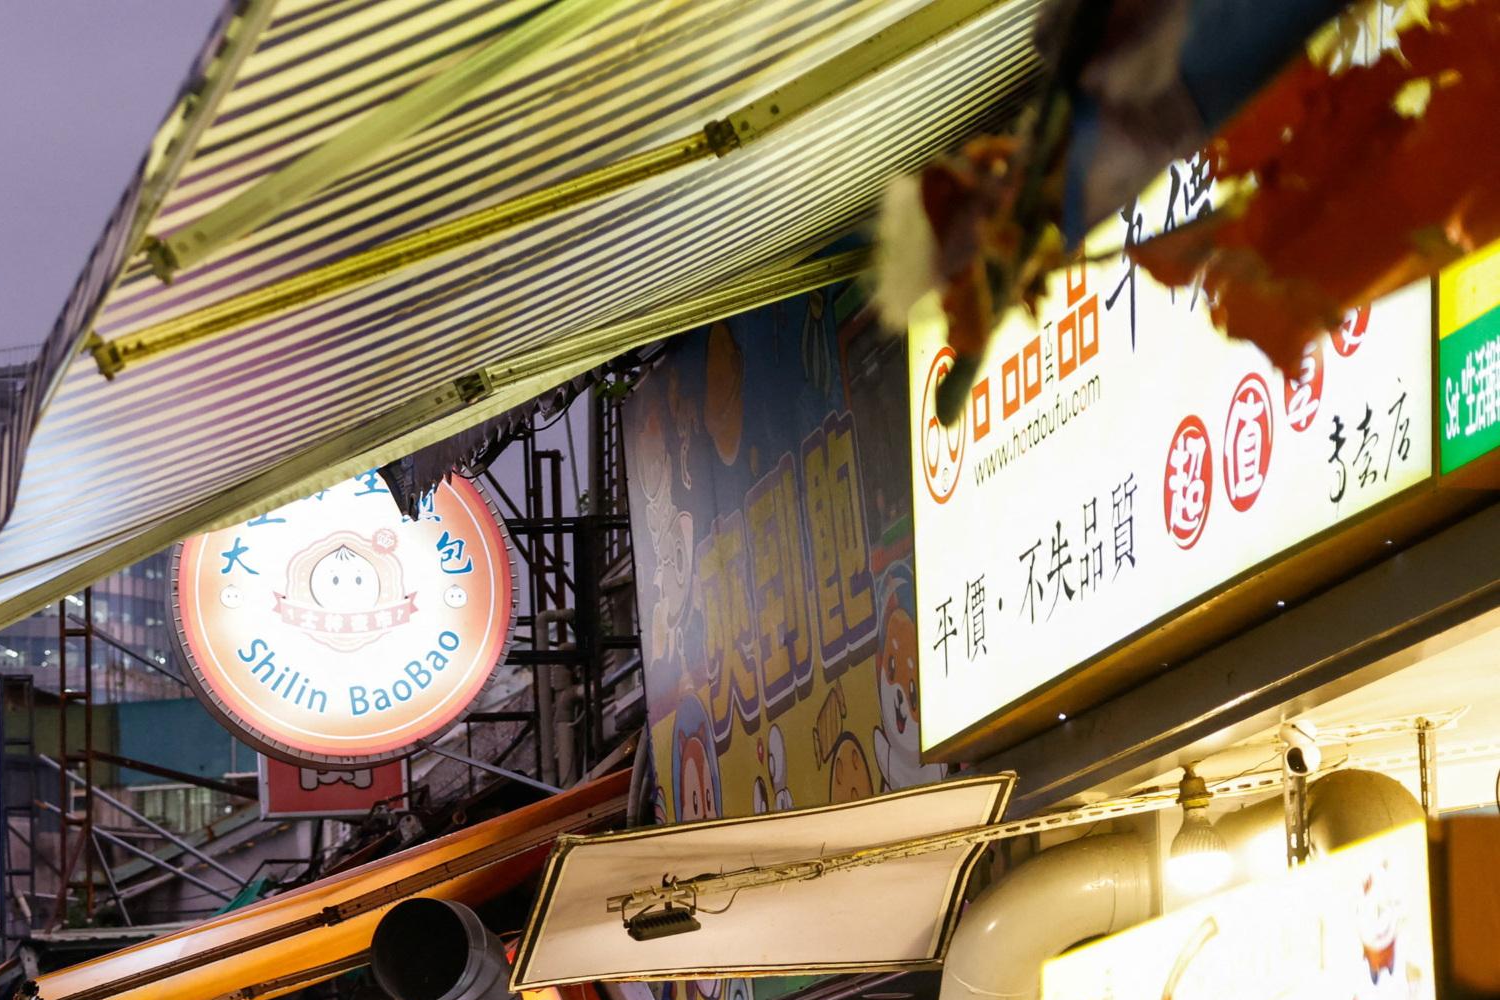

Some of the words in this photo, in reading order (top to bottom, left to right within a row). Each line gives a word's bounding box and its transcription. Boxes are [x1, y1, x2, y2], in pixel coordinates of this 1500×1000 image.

[974, 374, 1101, 486] www.hotdoufu.com
[238, 638, 328, 713] Shilin
[349, 629, 461, 717] BaoBao
